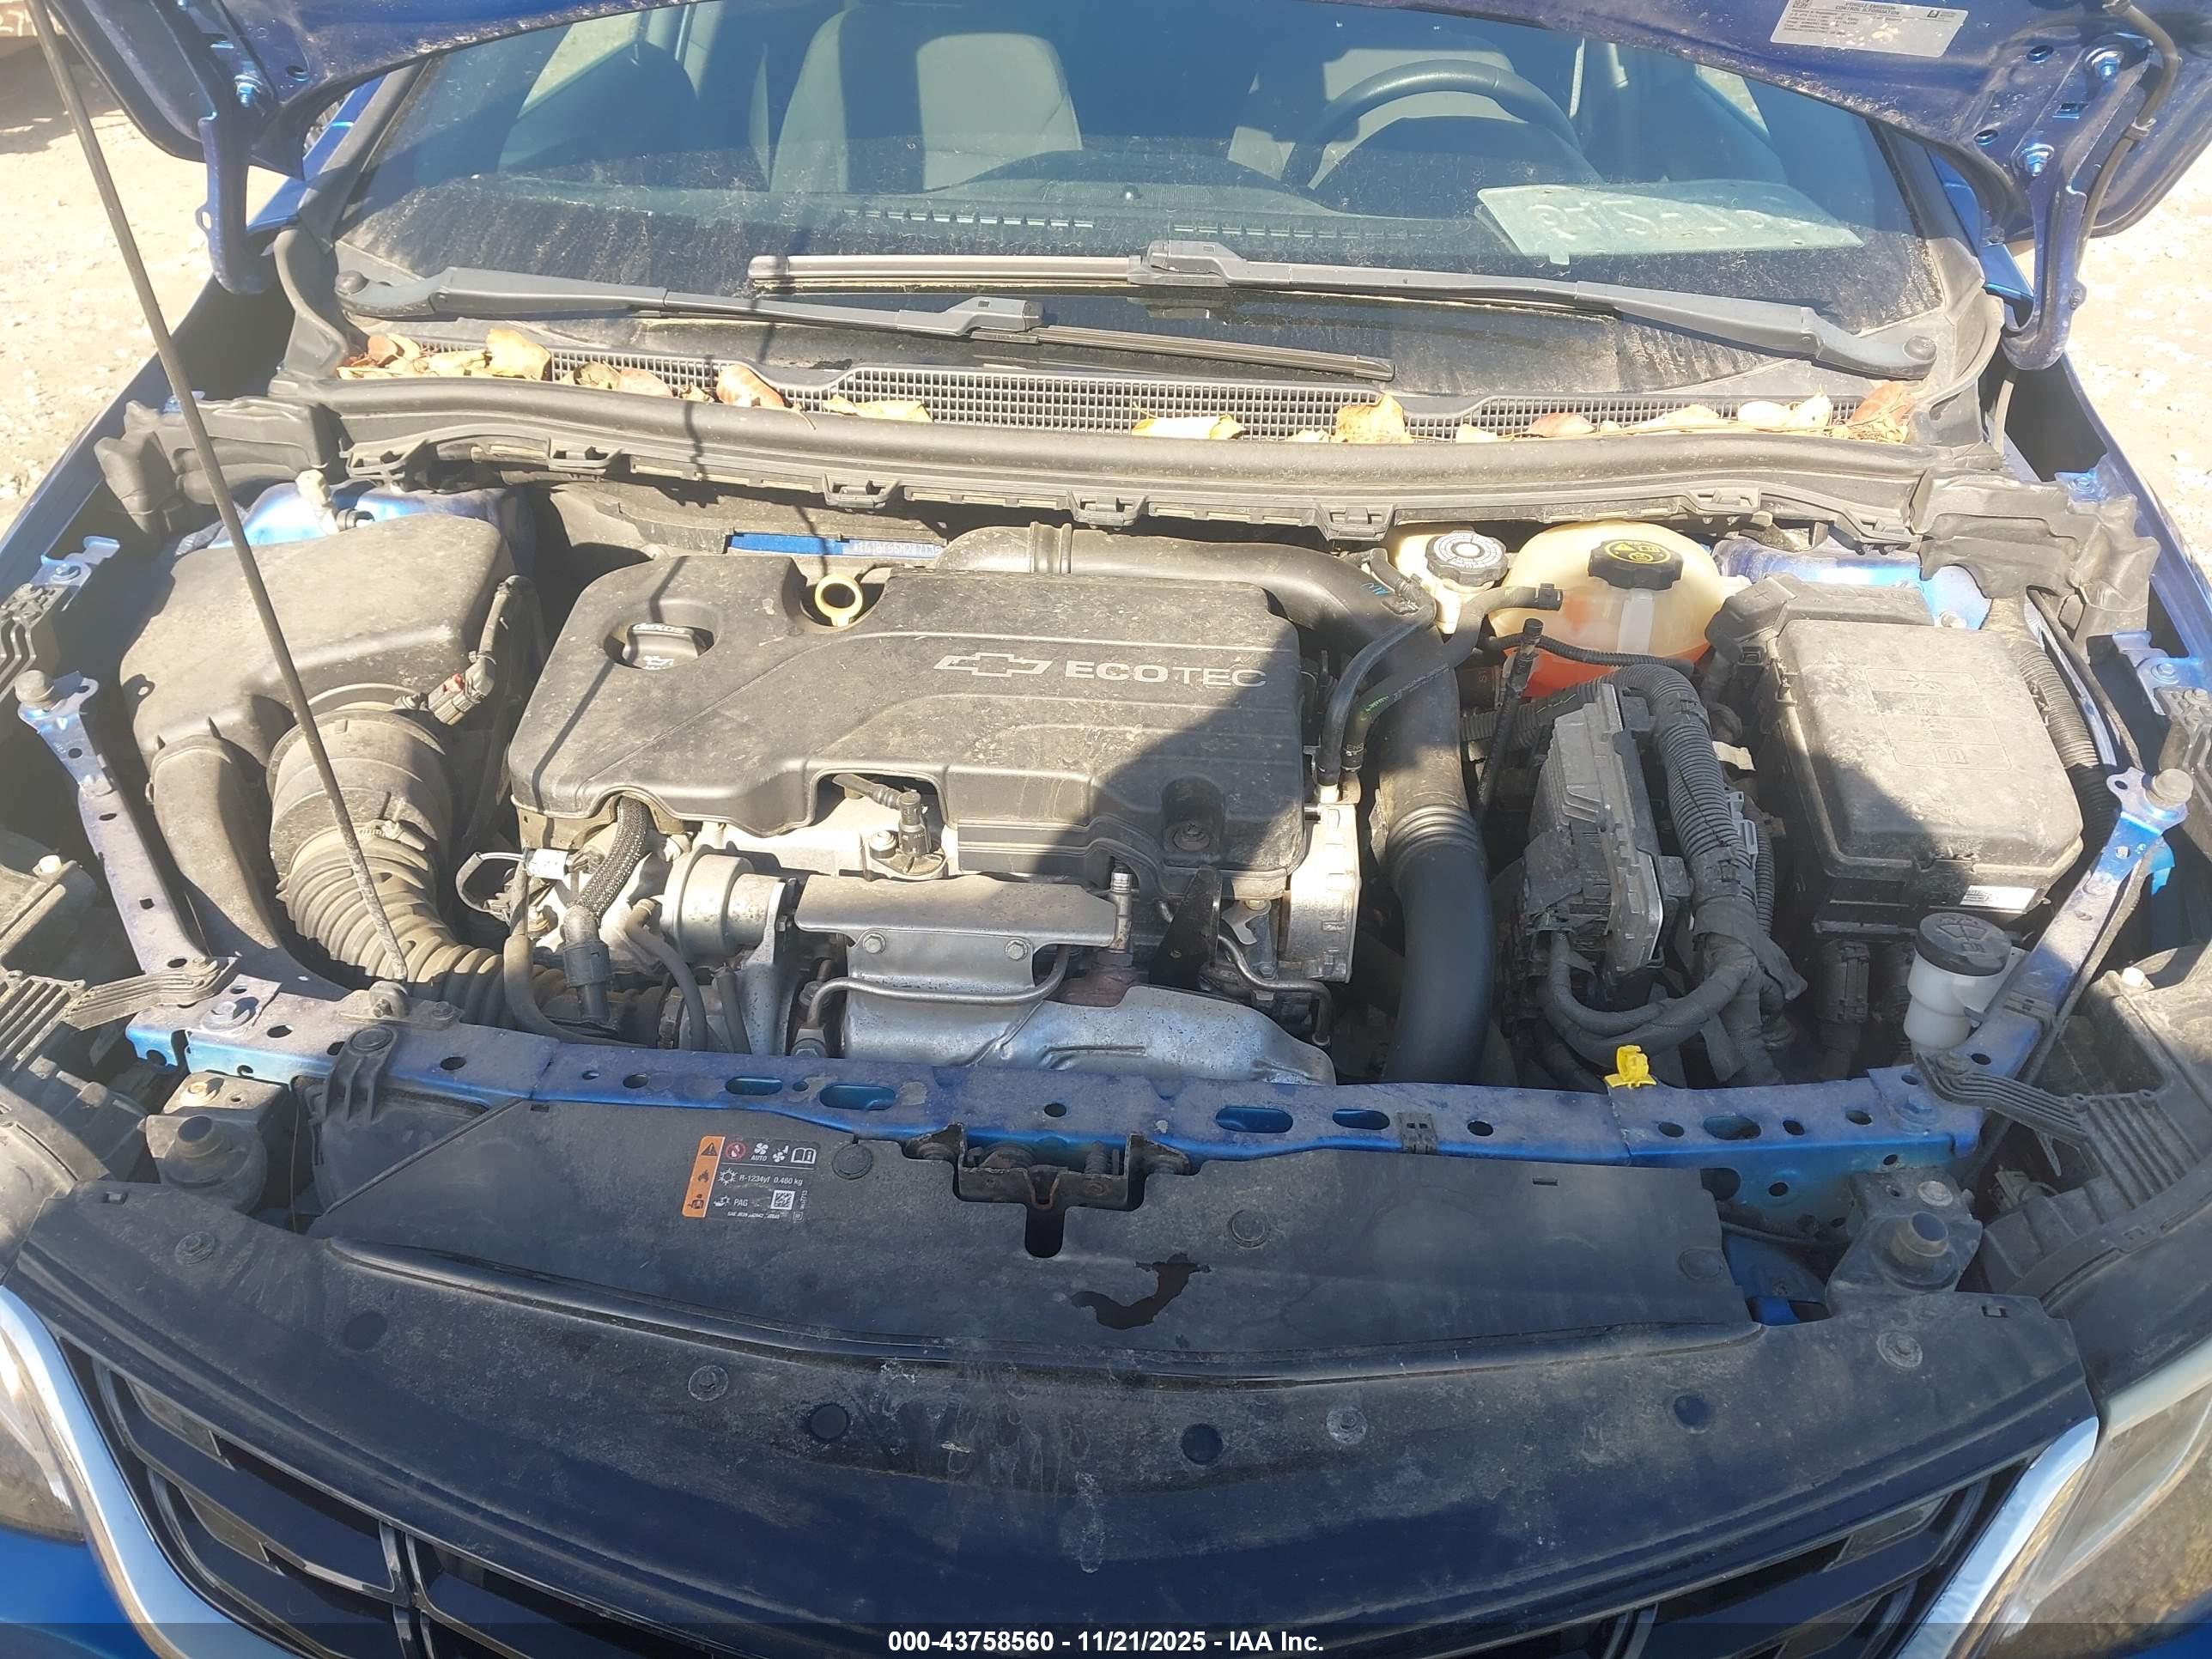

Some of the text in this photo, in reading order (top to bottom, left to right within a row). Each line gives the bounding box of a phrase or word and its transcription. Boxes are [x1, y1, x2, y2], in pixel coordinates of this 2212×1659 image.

[1064, 660, 1267, 687] ECOTEC
[794, 1178, 804, 1187] kg
[733, 1198, 749, 1206] PAG
